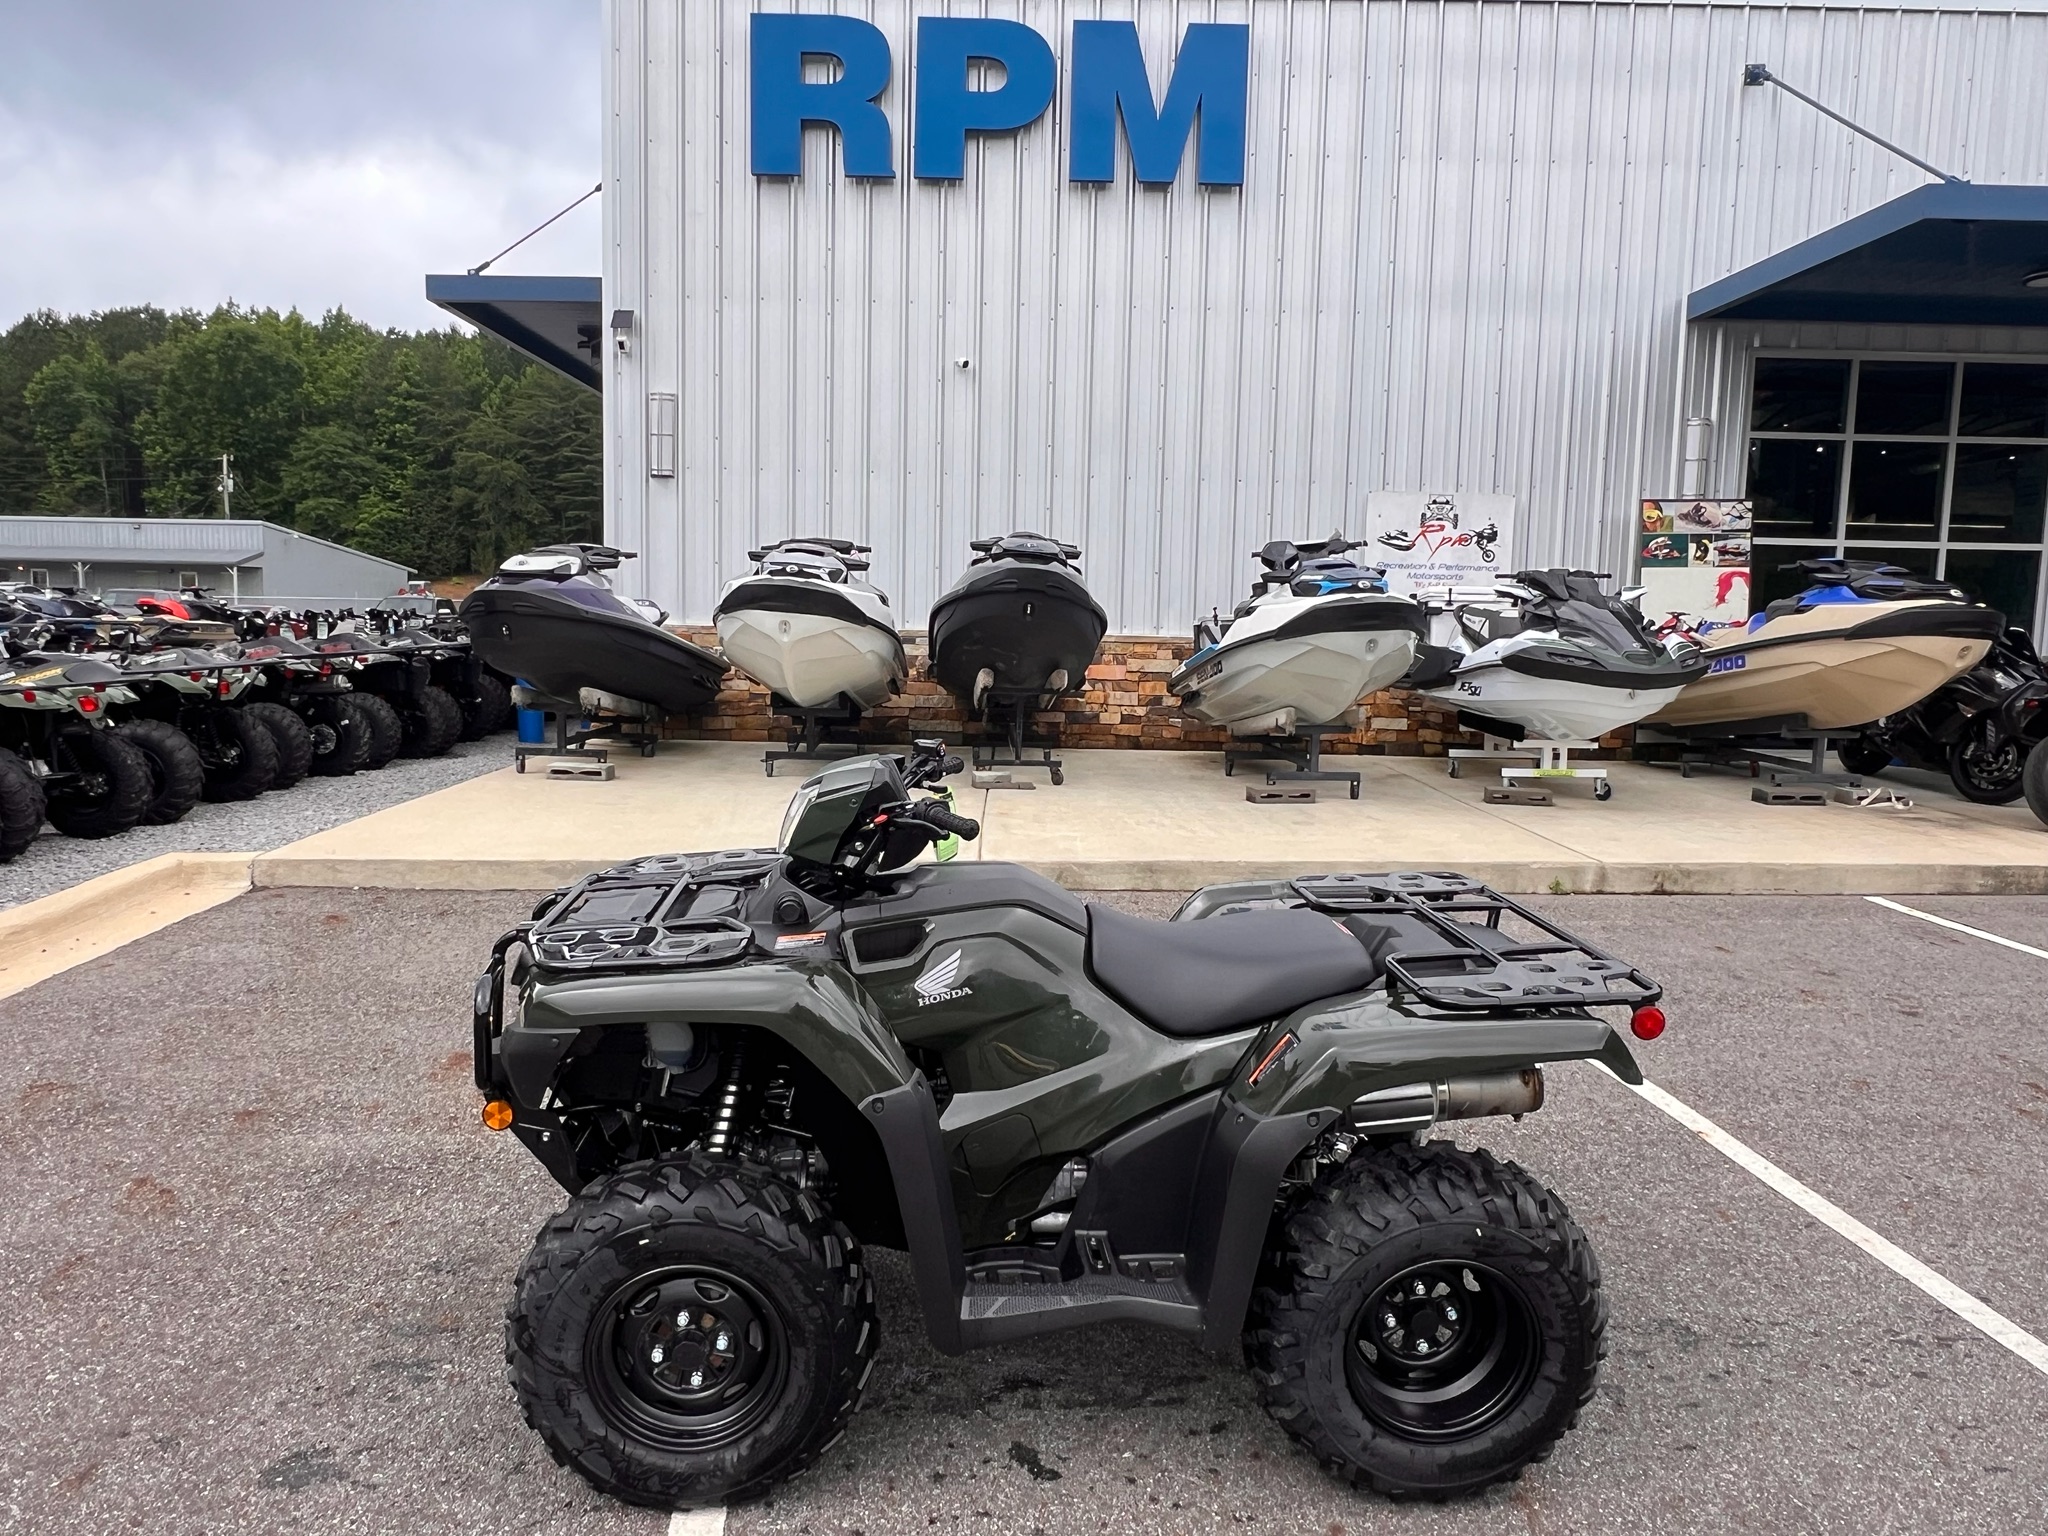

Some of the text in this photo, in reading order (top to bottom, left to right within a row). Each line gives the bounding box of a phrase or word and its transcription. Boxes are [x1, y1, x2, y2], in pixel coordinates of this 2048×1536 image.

[750, 13, 1249, 185] RPM
[1376, 561, 1500, 573] Recreation & Performance
[1406, 572, 1464, 582] Motorsports
[917, 987, 973, 1007] HONDA
